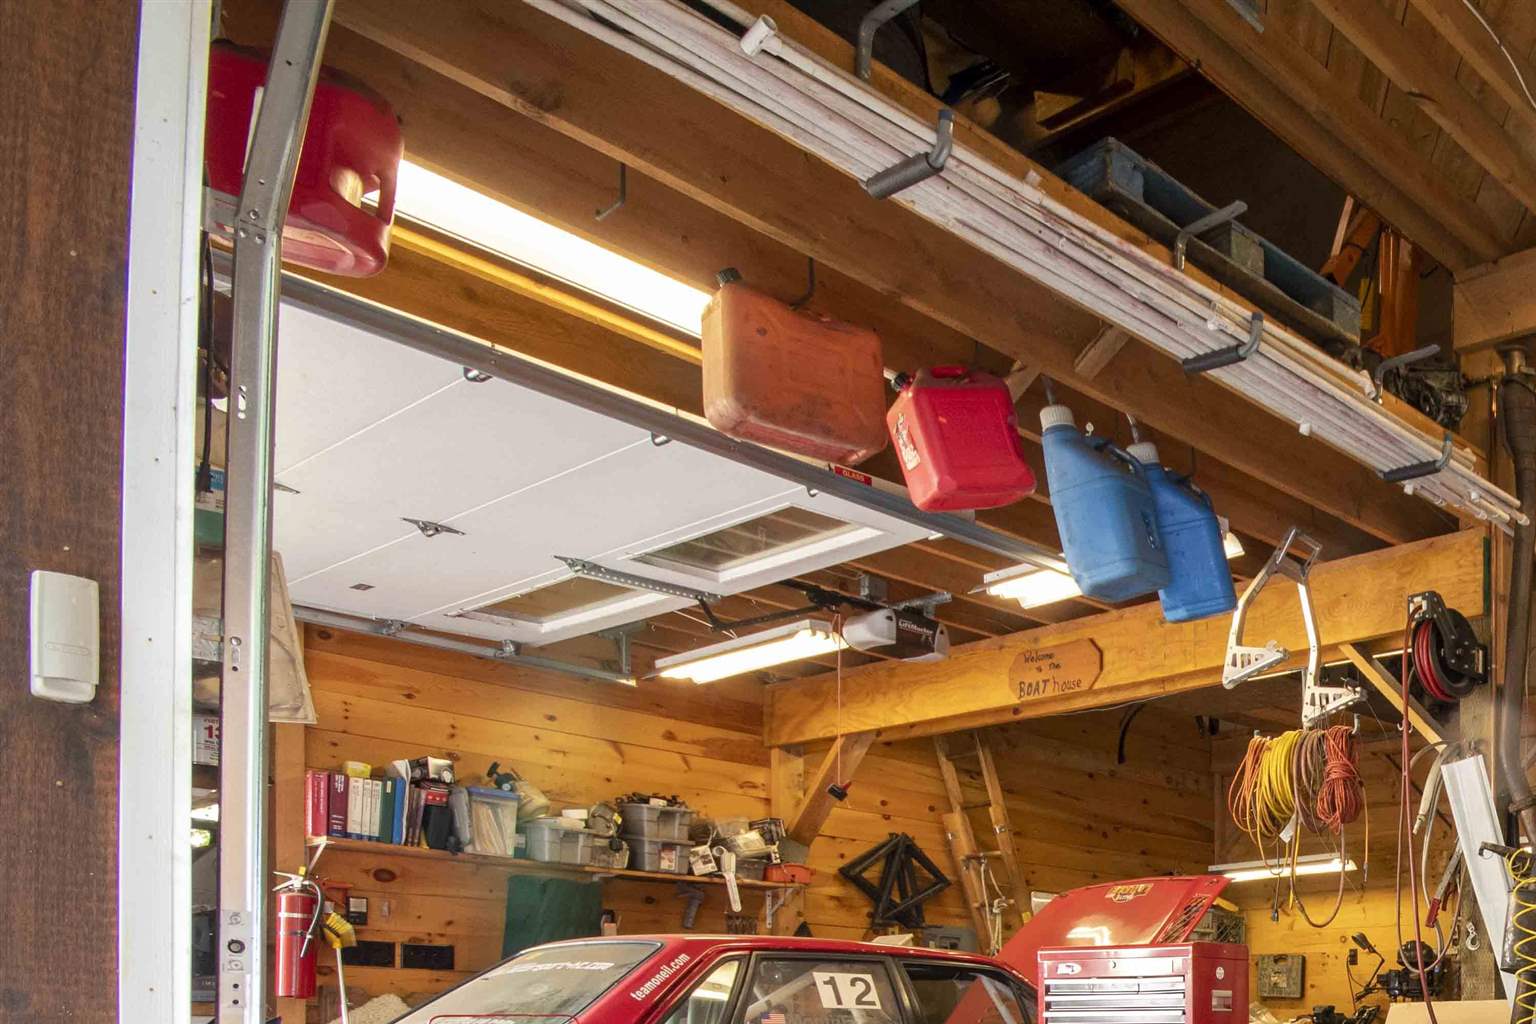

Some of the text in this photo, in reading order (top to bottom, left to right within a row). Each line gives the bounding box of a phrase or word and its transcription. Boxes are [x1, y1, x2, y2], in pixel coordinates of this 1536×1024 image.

[1018, 676, 1082, 698] BOAT house
[630, 953, 690, 1001] teamoneil.com
[823, 975, 877, 1006] 12
